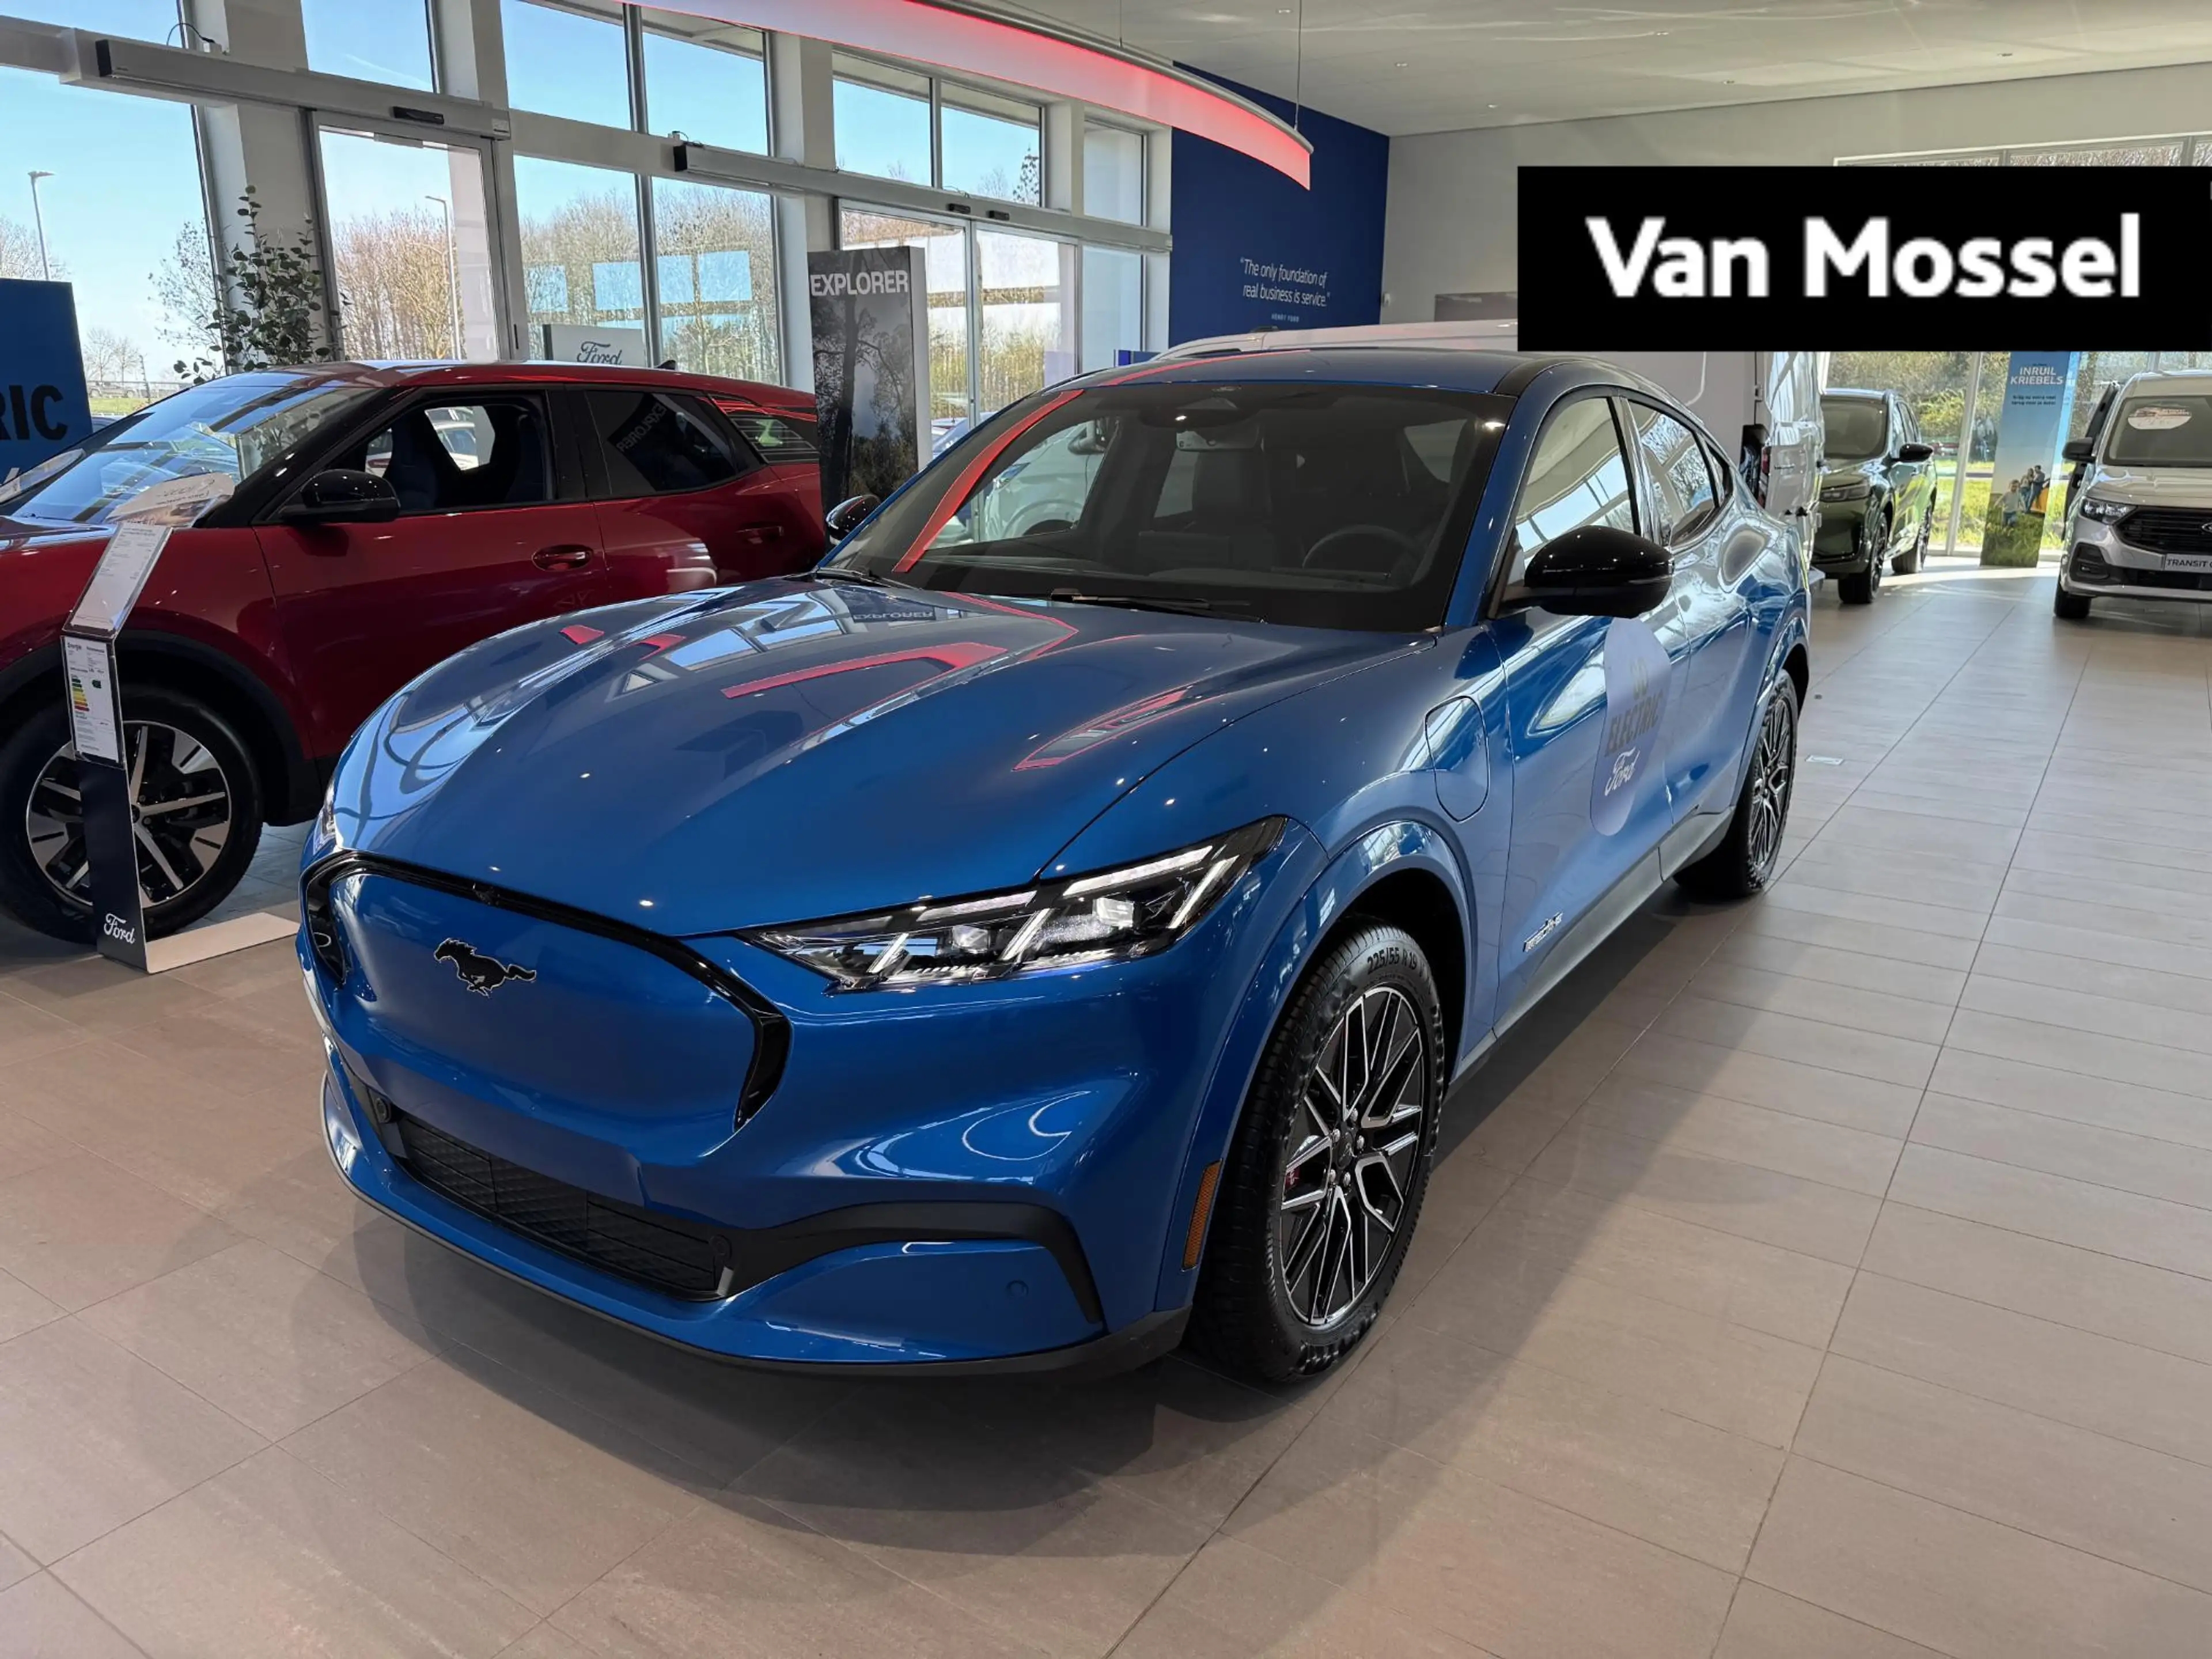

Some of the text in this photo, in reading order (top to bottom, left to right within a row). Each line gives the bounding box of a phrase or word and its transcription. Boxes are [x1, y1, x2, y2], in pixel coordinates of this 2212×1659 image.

[810, 270, 908, 297] EXPLORER
[1260, 263, 1278, 282] only
[1279, 264, 1317, 285] foundation
[1319, 272, 1328, 289] of
[1243, 283, 1258, 298] real
[1260, 283, 1293, 303] business
[1294, 289, 1300, 304] is
[577, 341, 622, 365] Ford
[2010, 376, 2063, 385] KRIEBELS
[2020, 366, 2056, 376] INRUIL
[2167, 558, 2209, 567] TRANSIT
[1605, 747, 1641, 796] Ford
[104, 913, 135, 944] Ford
[1367, 947, 1400, 975] 225/55
[1402, 948, 1408, 967] R
